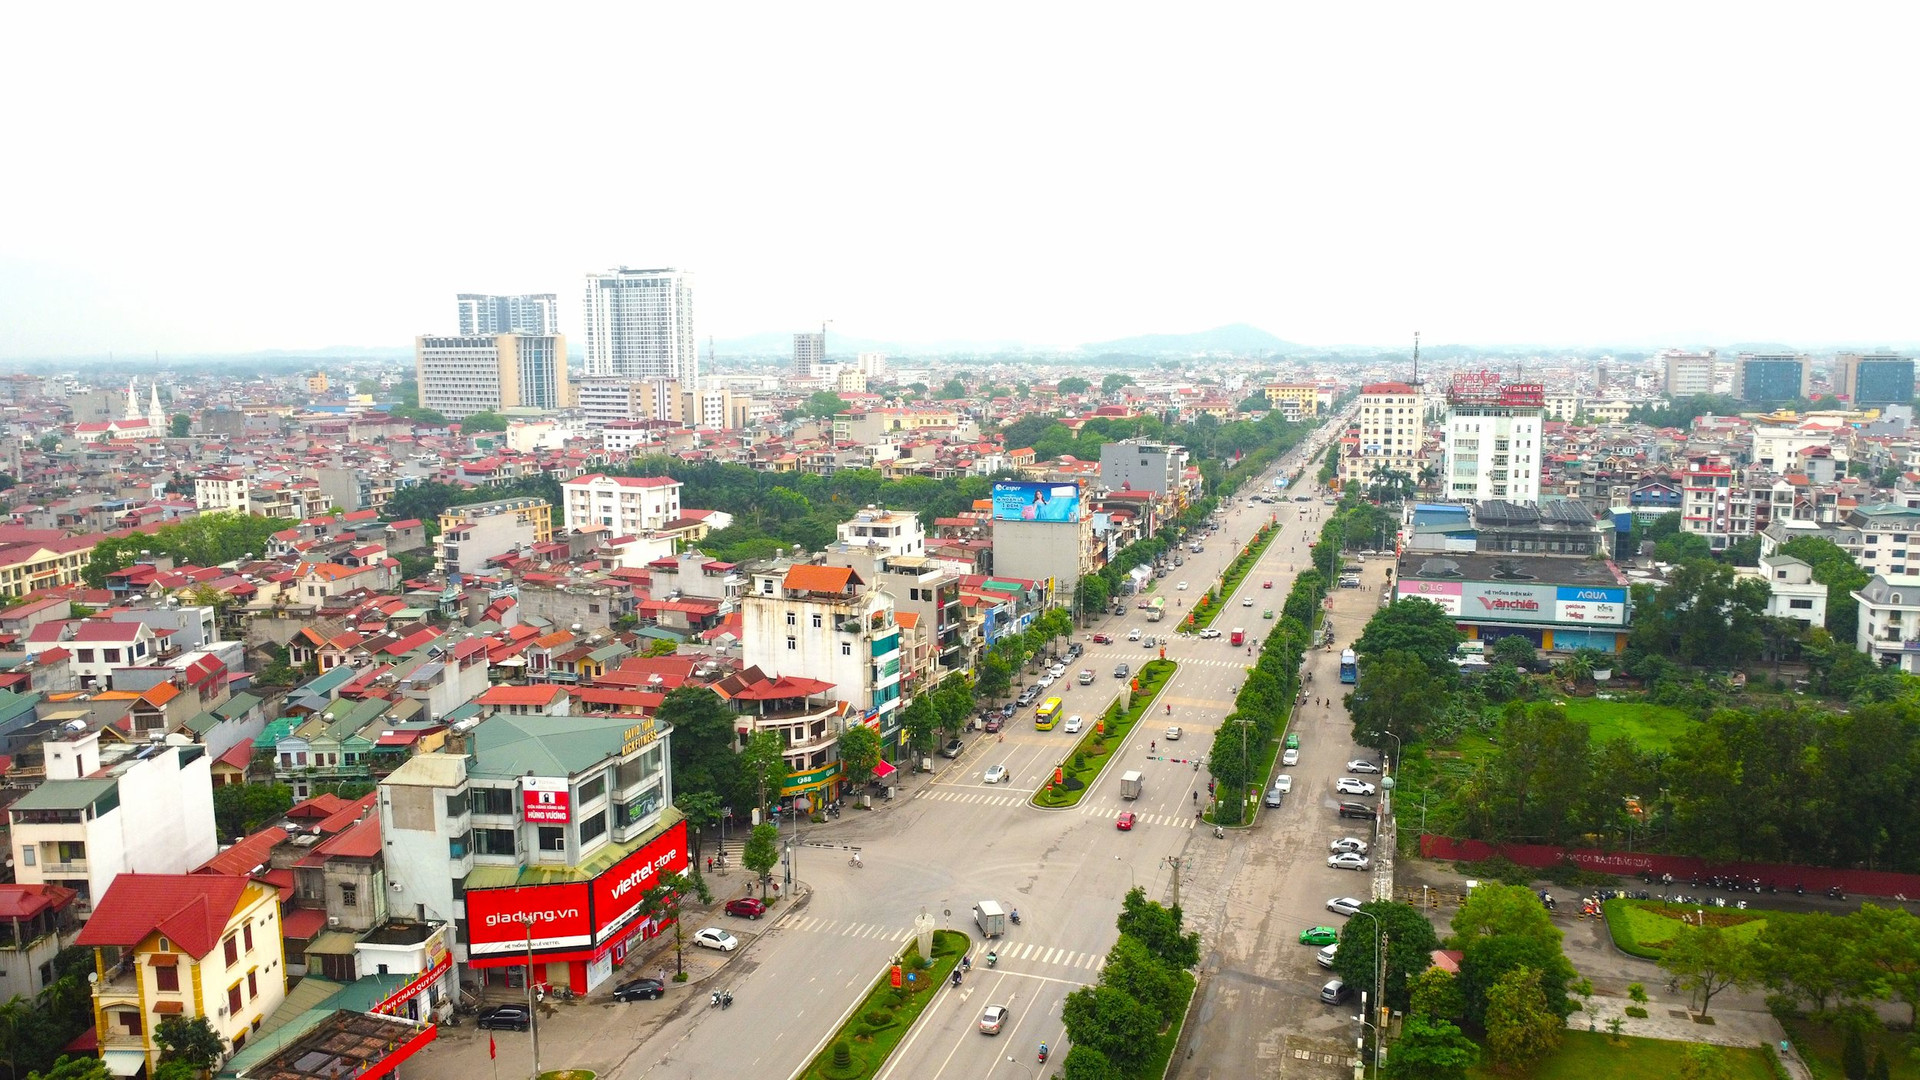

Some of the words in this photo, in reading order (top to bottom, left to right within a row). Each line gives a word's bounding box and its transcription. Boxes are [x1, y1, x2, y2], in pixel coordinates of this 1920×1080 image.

[1500, 384, 1544, 393] viettel
[1430, 583, 1443, 592] LG
[1576, 591, 1608, 600] AQUA
[624, 724, 640, 741] DAVID
[621, 728, 658, 757] KICKFITNESS
[528, 810, 545, 818] HÙNG
[546, 811, 567, 819] VƯƠNG
[611, 861, 654, 900] viettel
[654, 849, 677, 871] store
[397, 987, 416, 1003] CHÀO
[429, 963, 447, 982] KHÁCH
